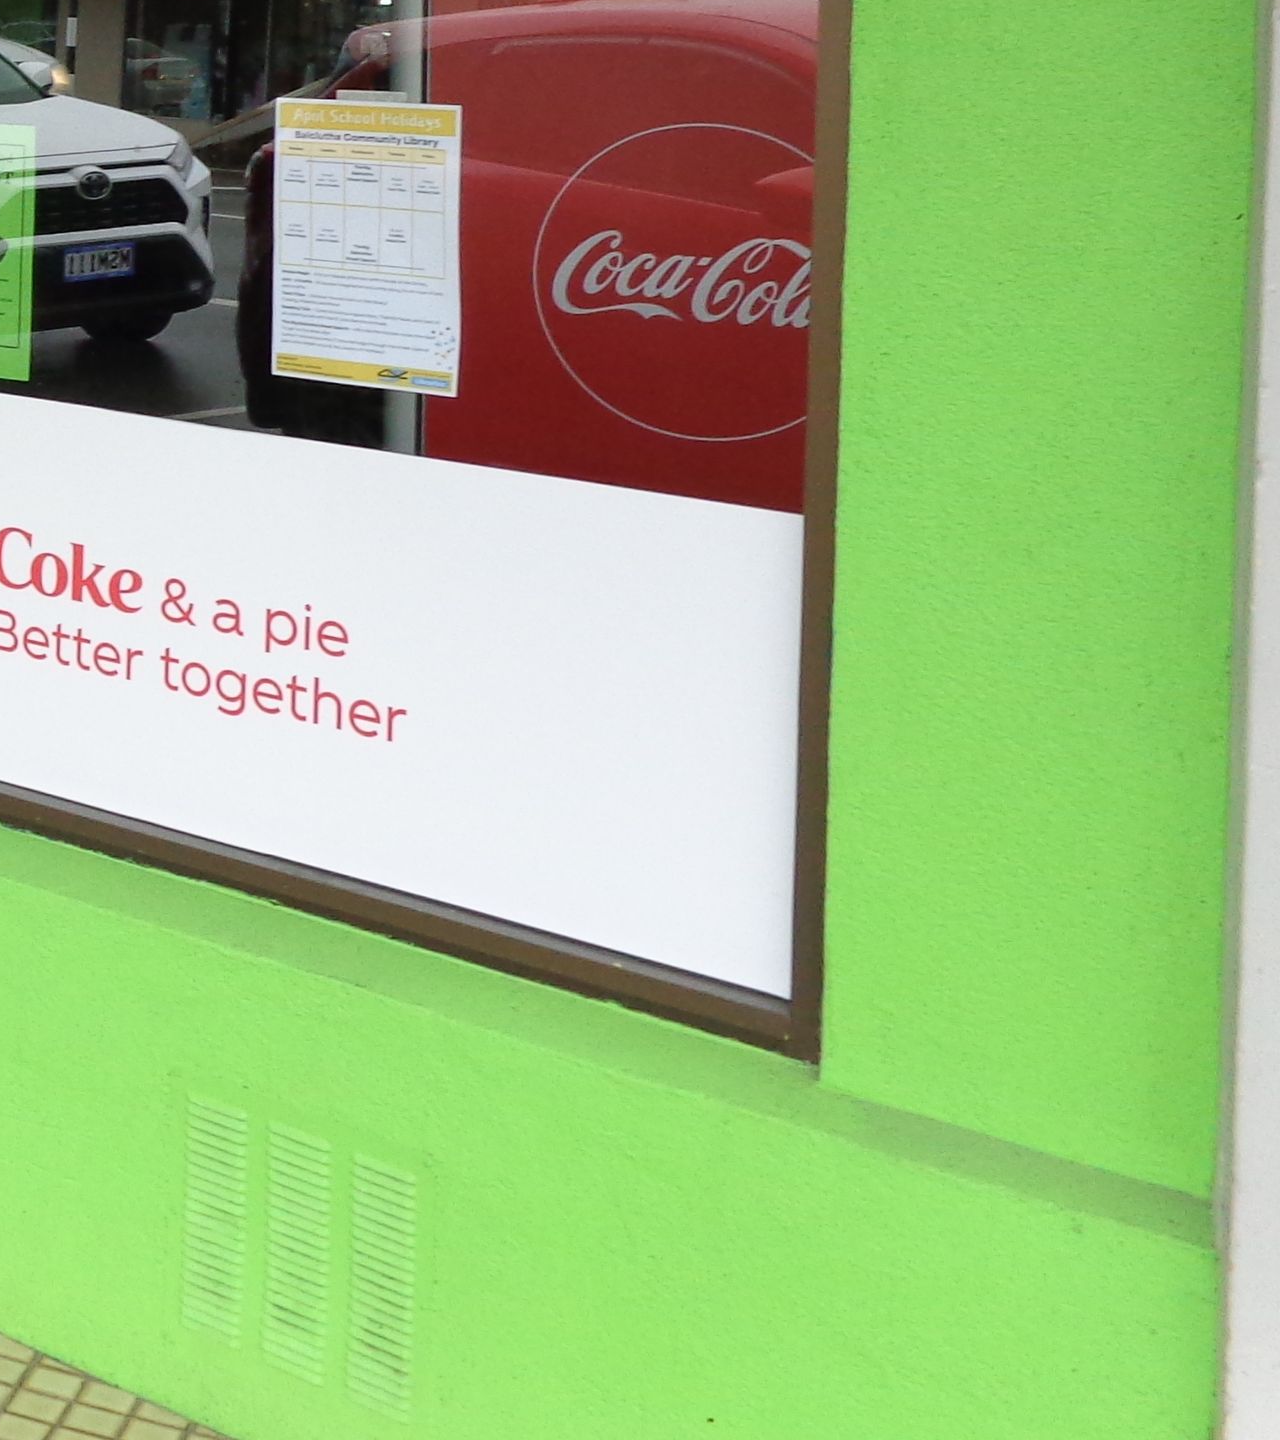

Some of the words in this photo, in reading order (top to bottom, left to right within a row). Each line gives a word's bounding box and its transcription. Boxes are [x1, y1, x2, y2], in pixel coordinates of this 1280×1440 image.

[293, 108, 325, 124] April
[330, 109, 375, 125] School
[381, 112, 442, 130] Holidays
[343, 133, 402, 146] Community
[403, 137, 439, 148] Library
[160, 578, 196, 627] &
[212, 599, 244, 637] a
[265, 604, 350, 658] pie
[160, 647, 408, 742] together
